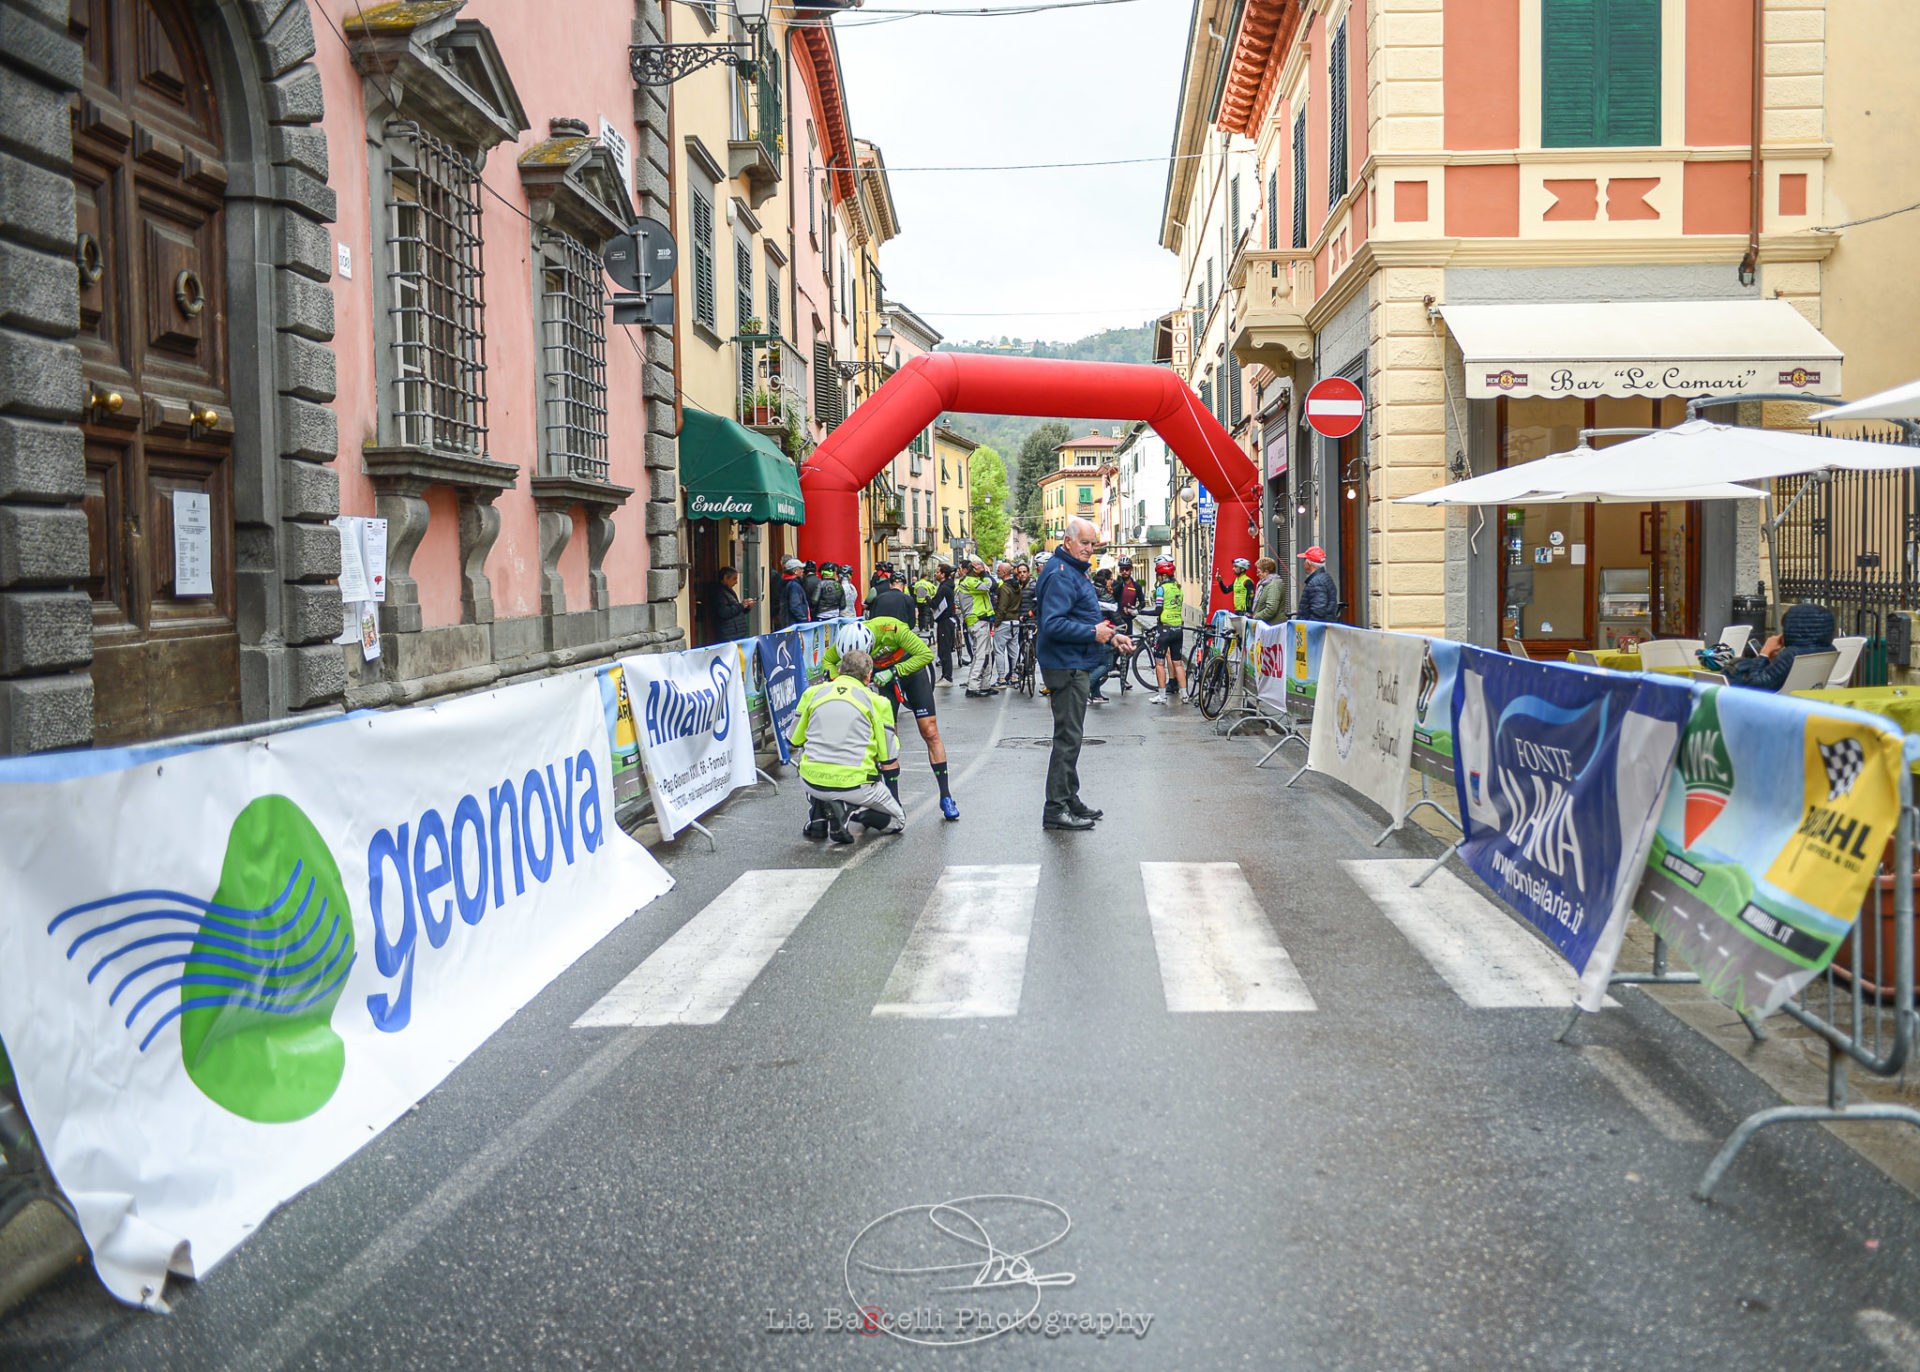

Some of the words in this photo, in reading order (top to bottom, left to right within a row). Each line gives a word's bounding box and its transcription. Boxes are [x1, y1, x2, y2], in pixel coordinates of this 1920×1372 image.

[1174, 312, 1187, 382] HOTE
[1550, 369, 1604, 391] Bar
[1662, 366, 1757, 391] Comari”
[691, 494, 753, 513] Enoteca
[645, 679, 714, 748] Allianz
[1514, 737, 1574, 782] FONTE
[1497, 764, 1585, 892] ILARIA
[367, 748, 604, 1033] geonova
